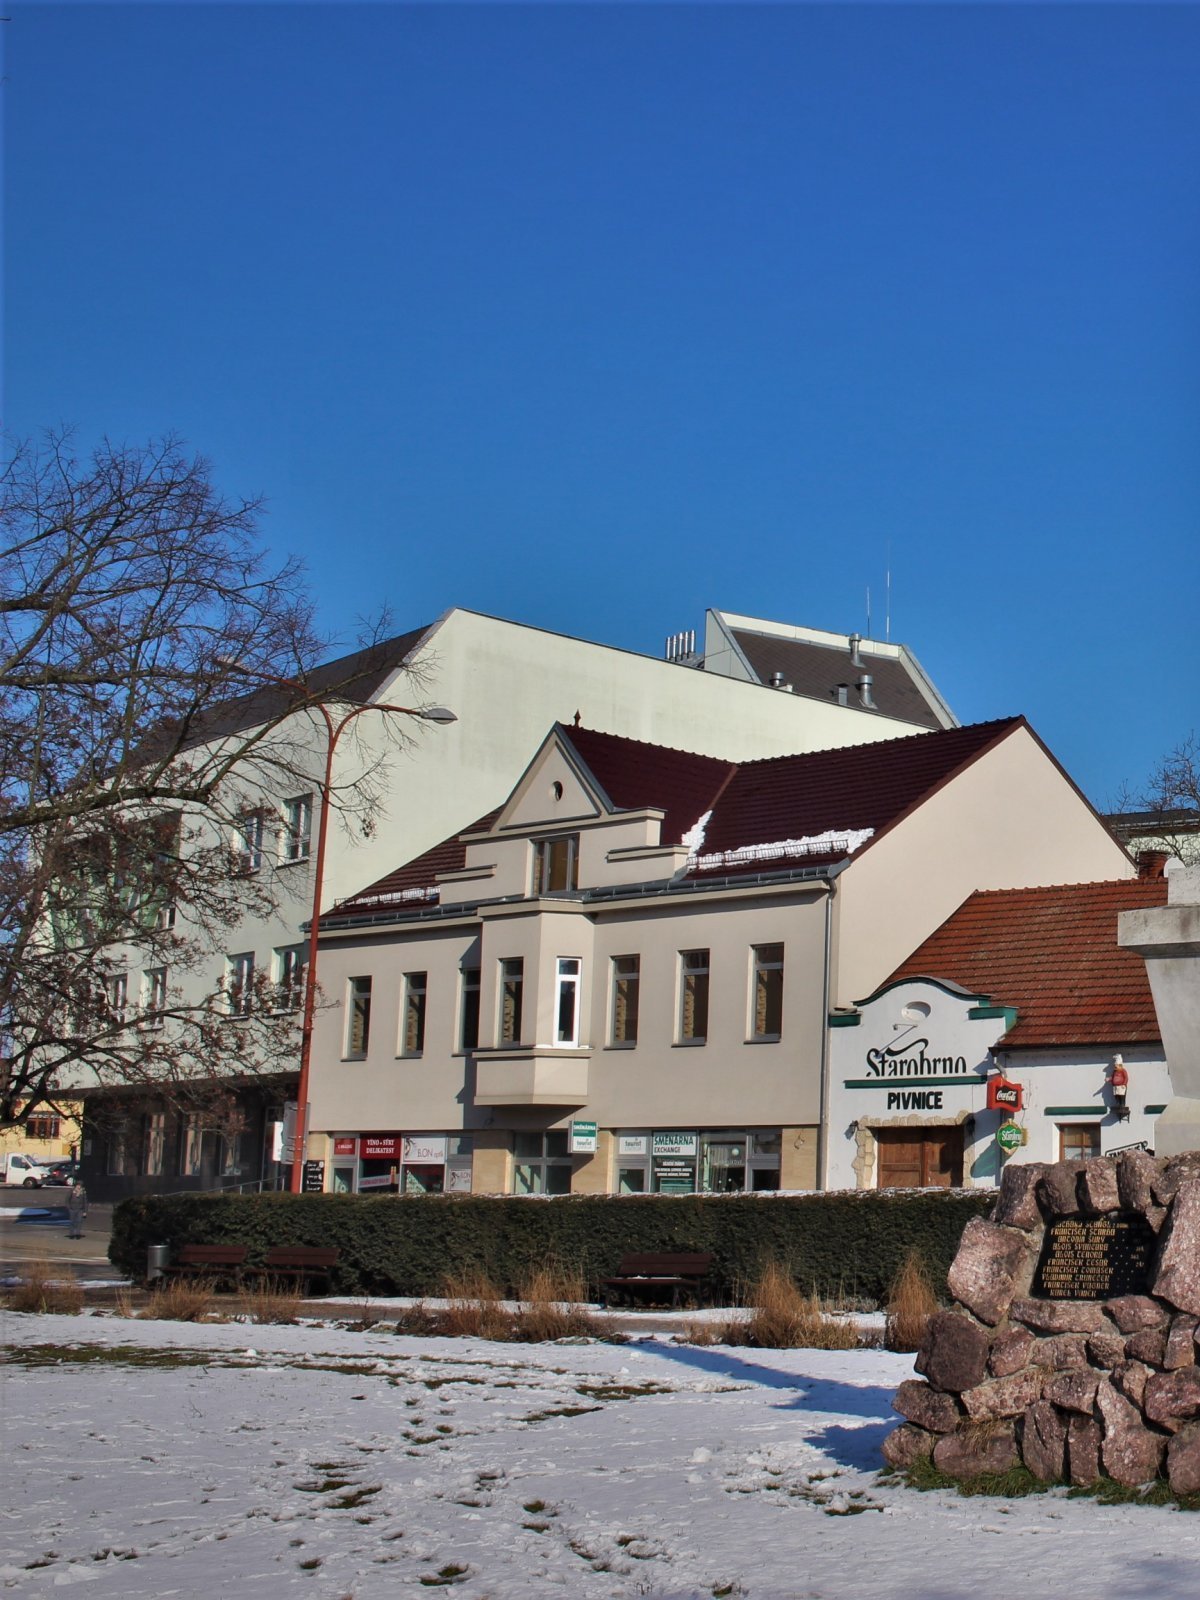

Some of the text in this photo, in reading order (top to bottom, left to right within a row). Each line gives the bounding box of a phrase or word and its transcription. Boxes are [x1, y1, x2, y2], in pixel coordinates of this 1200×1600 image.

[866, 1038, 967, 1077] Starobrno
[887, 1091, 943, 1110] PIVNICE
[997, 1091, 1016, 1101] Coca-Cola
[654, 1135, 694, 1145] SMĚNÁRNA
